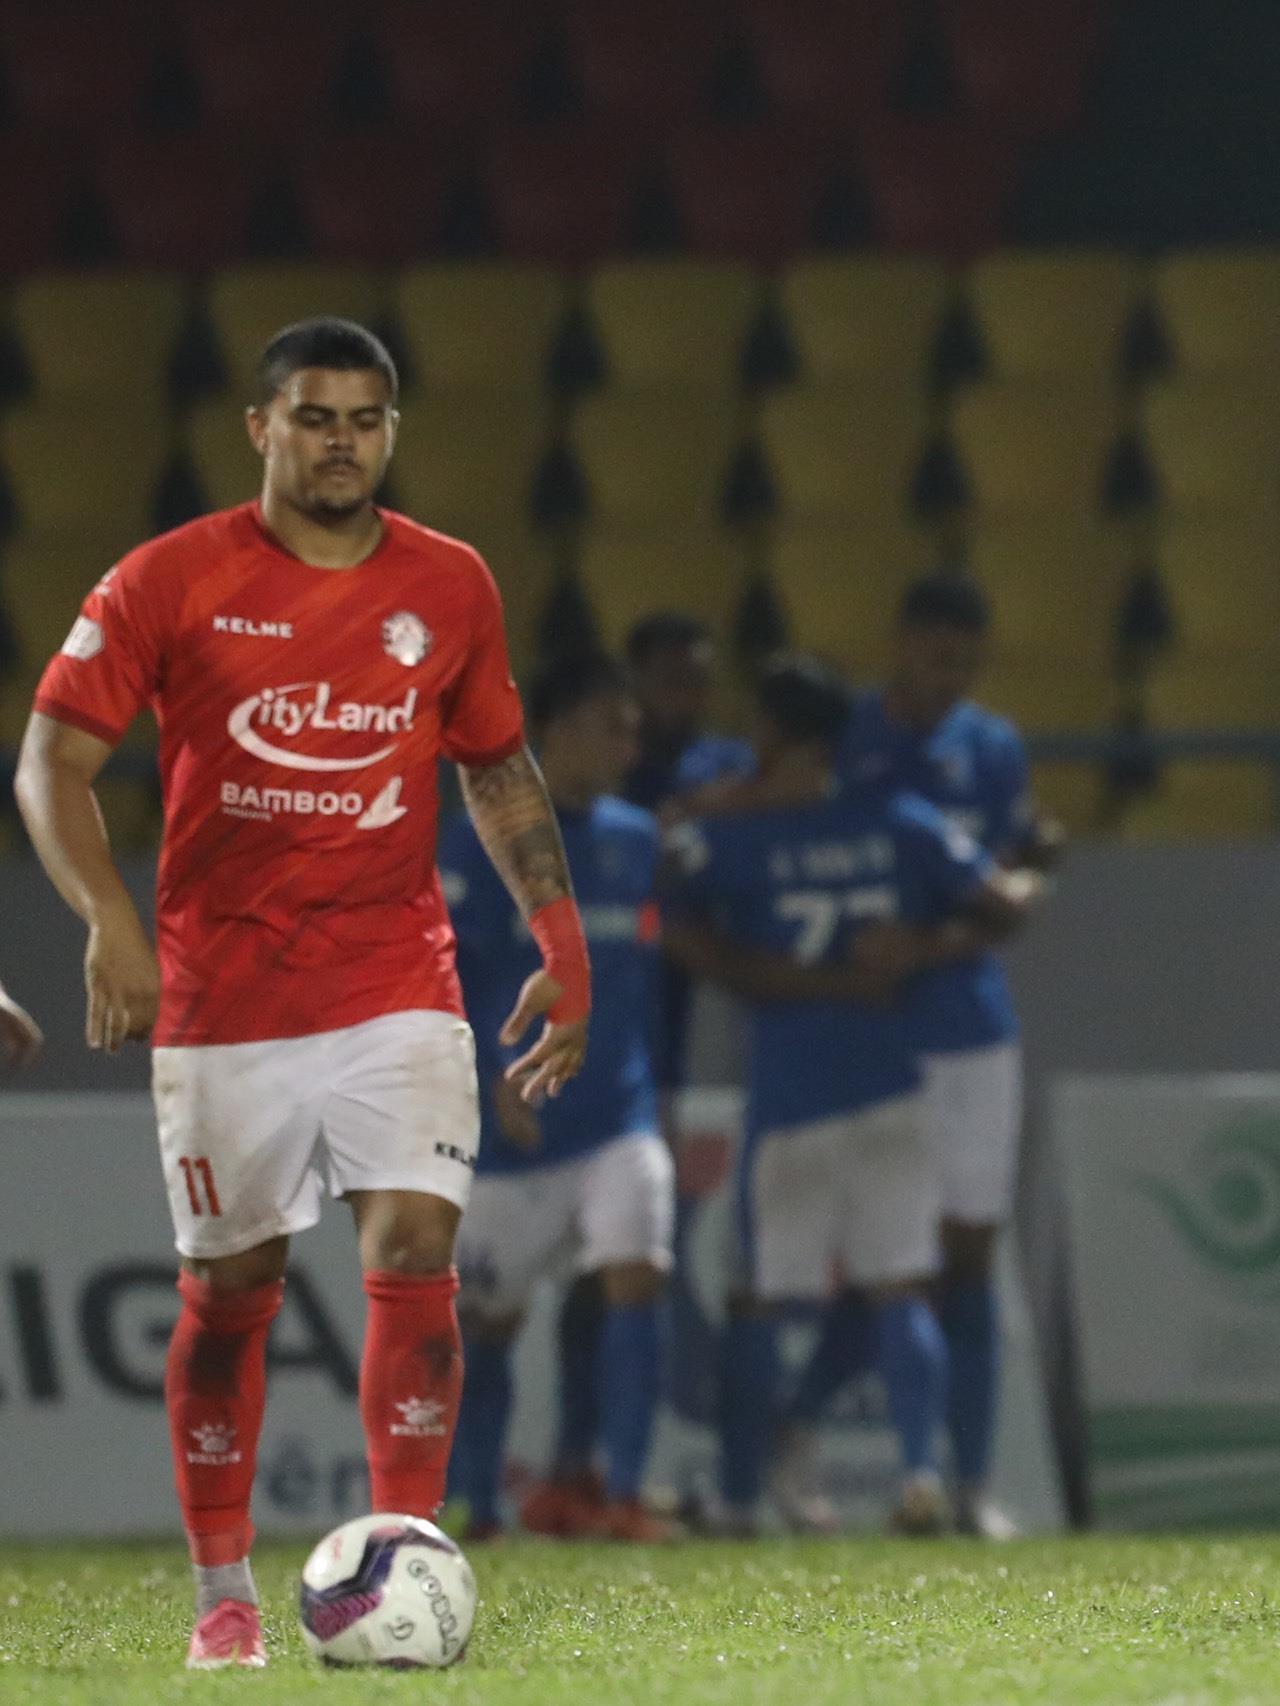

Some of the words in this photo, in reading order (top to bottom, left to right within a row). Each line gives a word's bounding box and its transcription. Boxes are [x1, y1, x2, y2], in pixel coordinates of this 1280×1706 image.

[213, 616, 294, 639] KELME
[220, 782, 363, 815] BAMBOO
[179, 1156, 221, 1217] 11
[0, 1258, 362, 1408] IGA
